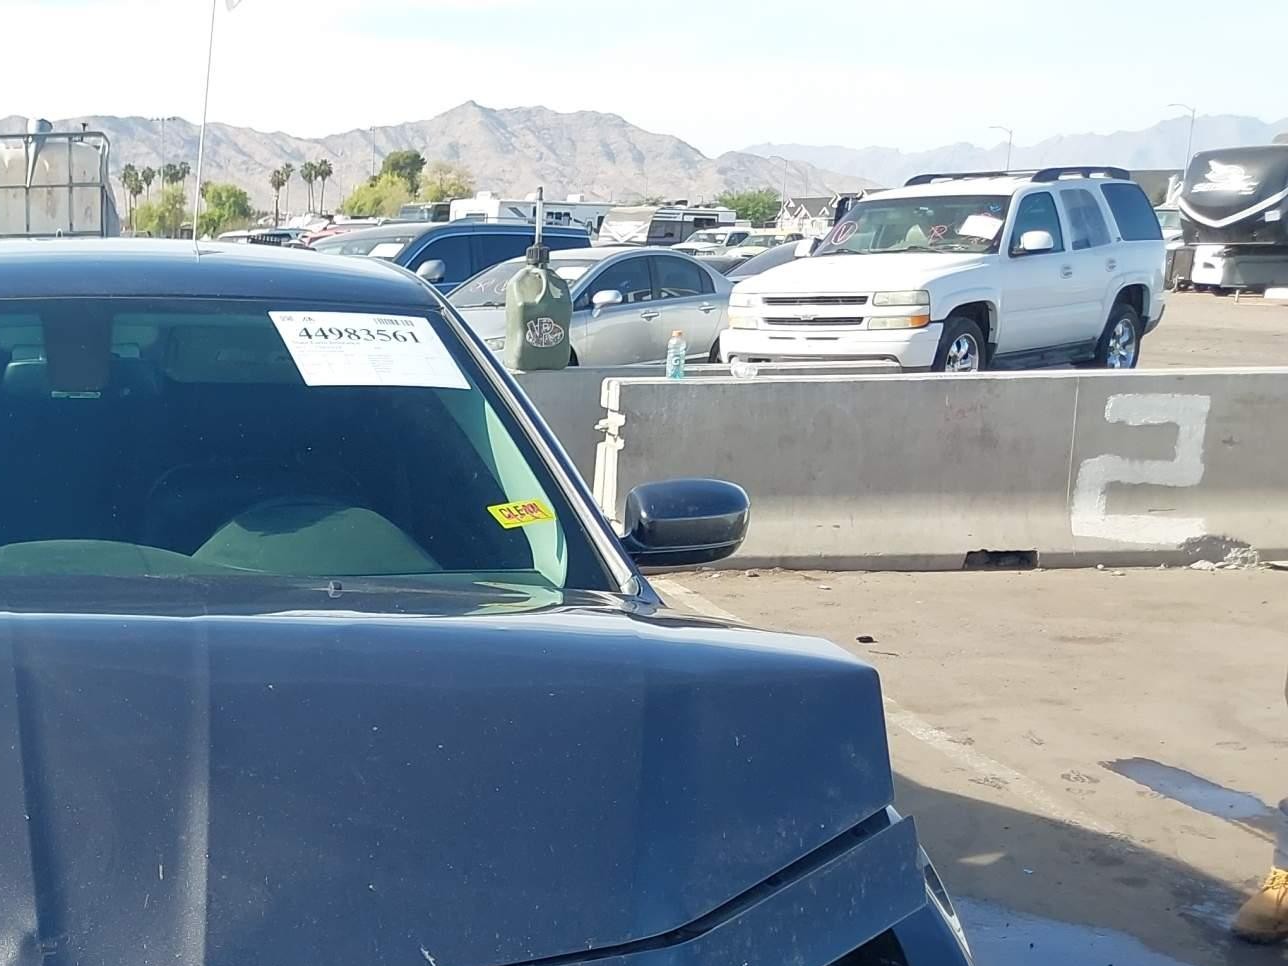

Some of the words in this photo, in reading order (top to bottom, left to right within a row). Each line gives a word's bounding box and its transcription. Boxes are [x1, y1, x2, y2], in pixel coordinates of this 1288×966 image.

[298, 326, 421, 344] 44983561
[671, 356, 681, 366] G
[1071, 393, 1211, 544] 2
